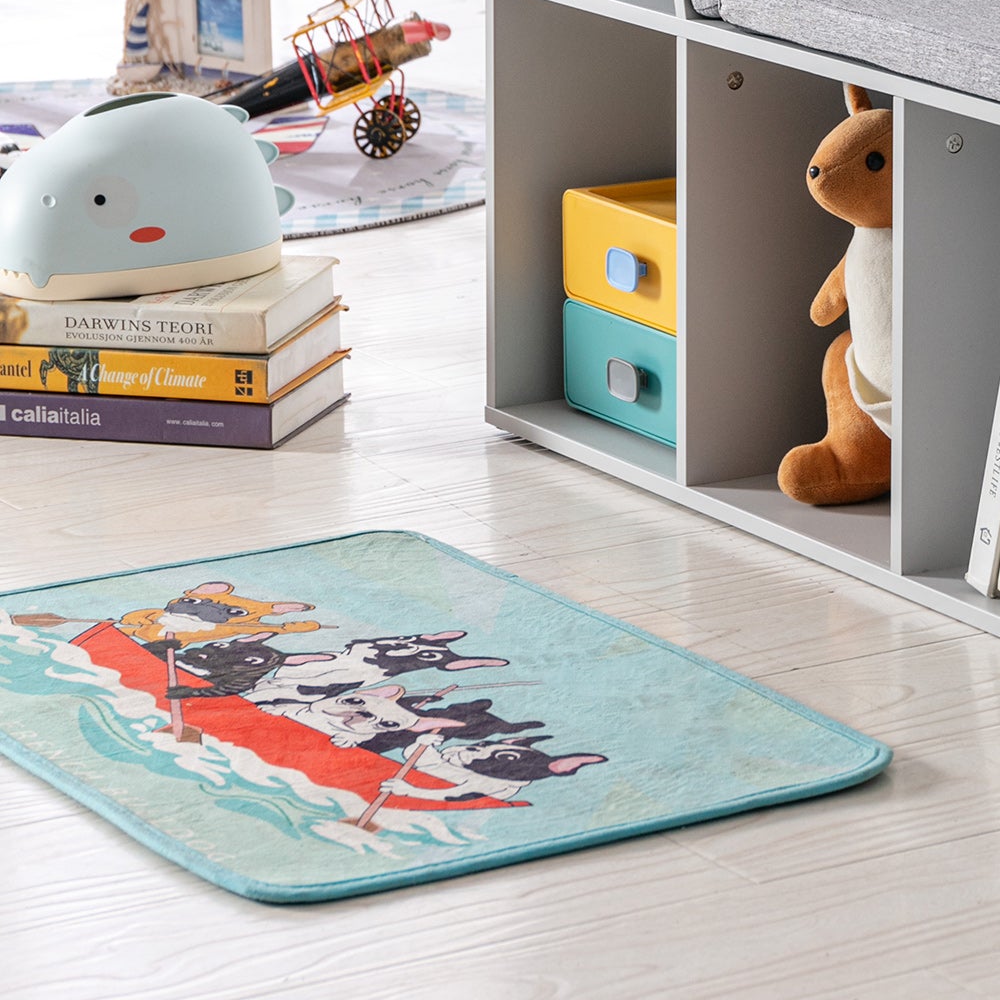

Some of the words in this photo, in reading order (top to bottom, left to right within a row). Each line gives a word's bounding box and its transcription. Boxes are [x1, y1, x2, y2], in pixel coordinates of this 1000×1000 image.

[65, 316, 151, 333] DARWINS
[156, 320, 214, 335] TEORI
[65, 331, 123, 342] EVOLUSJON
[125, 334, 176, 344] GJENNOM
[178, 337, 198, 345] 400
[199, 335, 214, 346] ÅR
[77, 363, 88, 382] A
[89, 363, 140, 390] Change
[139, 365, 156, 391] of
[154, 366, 207, 389] Climate
[11, 404, 102, 427] caliaitalia
